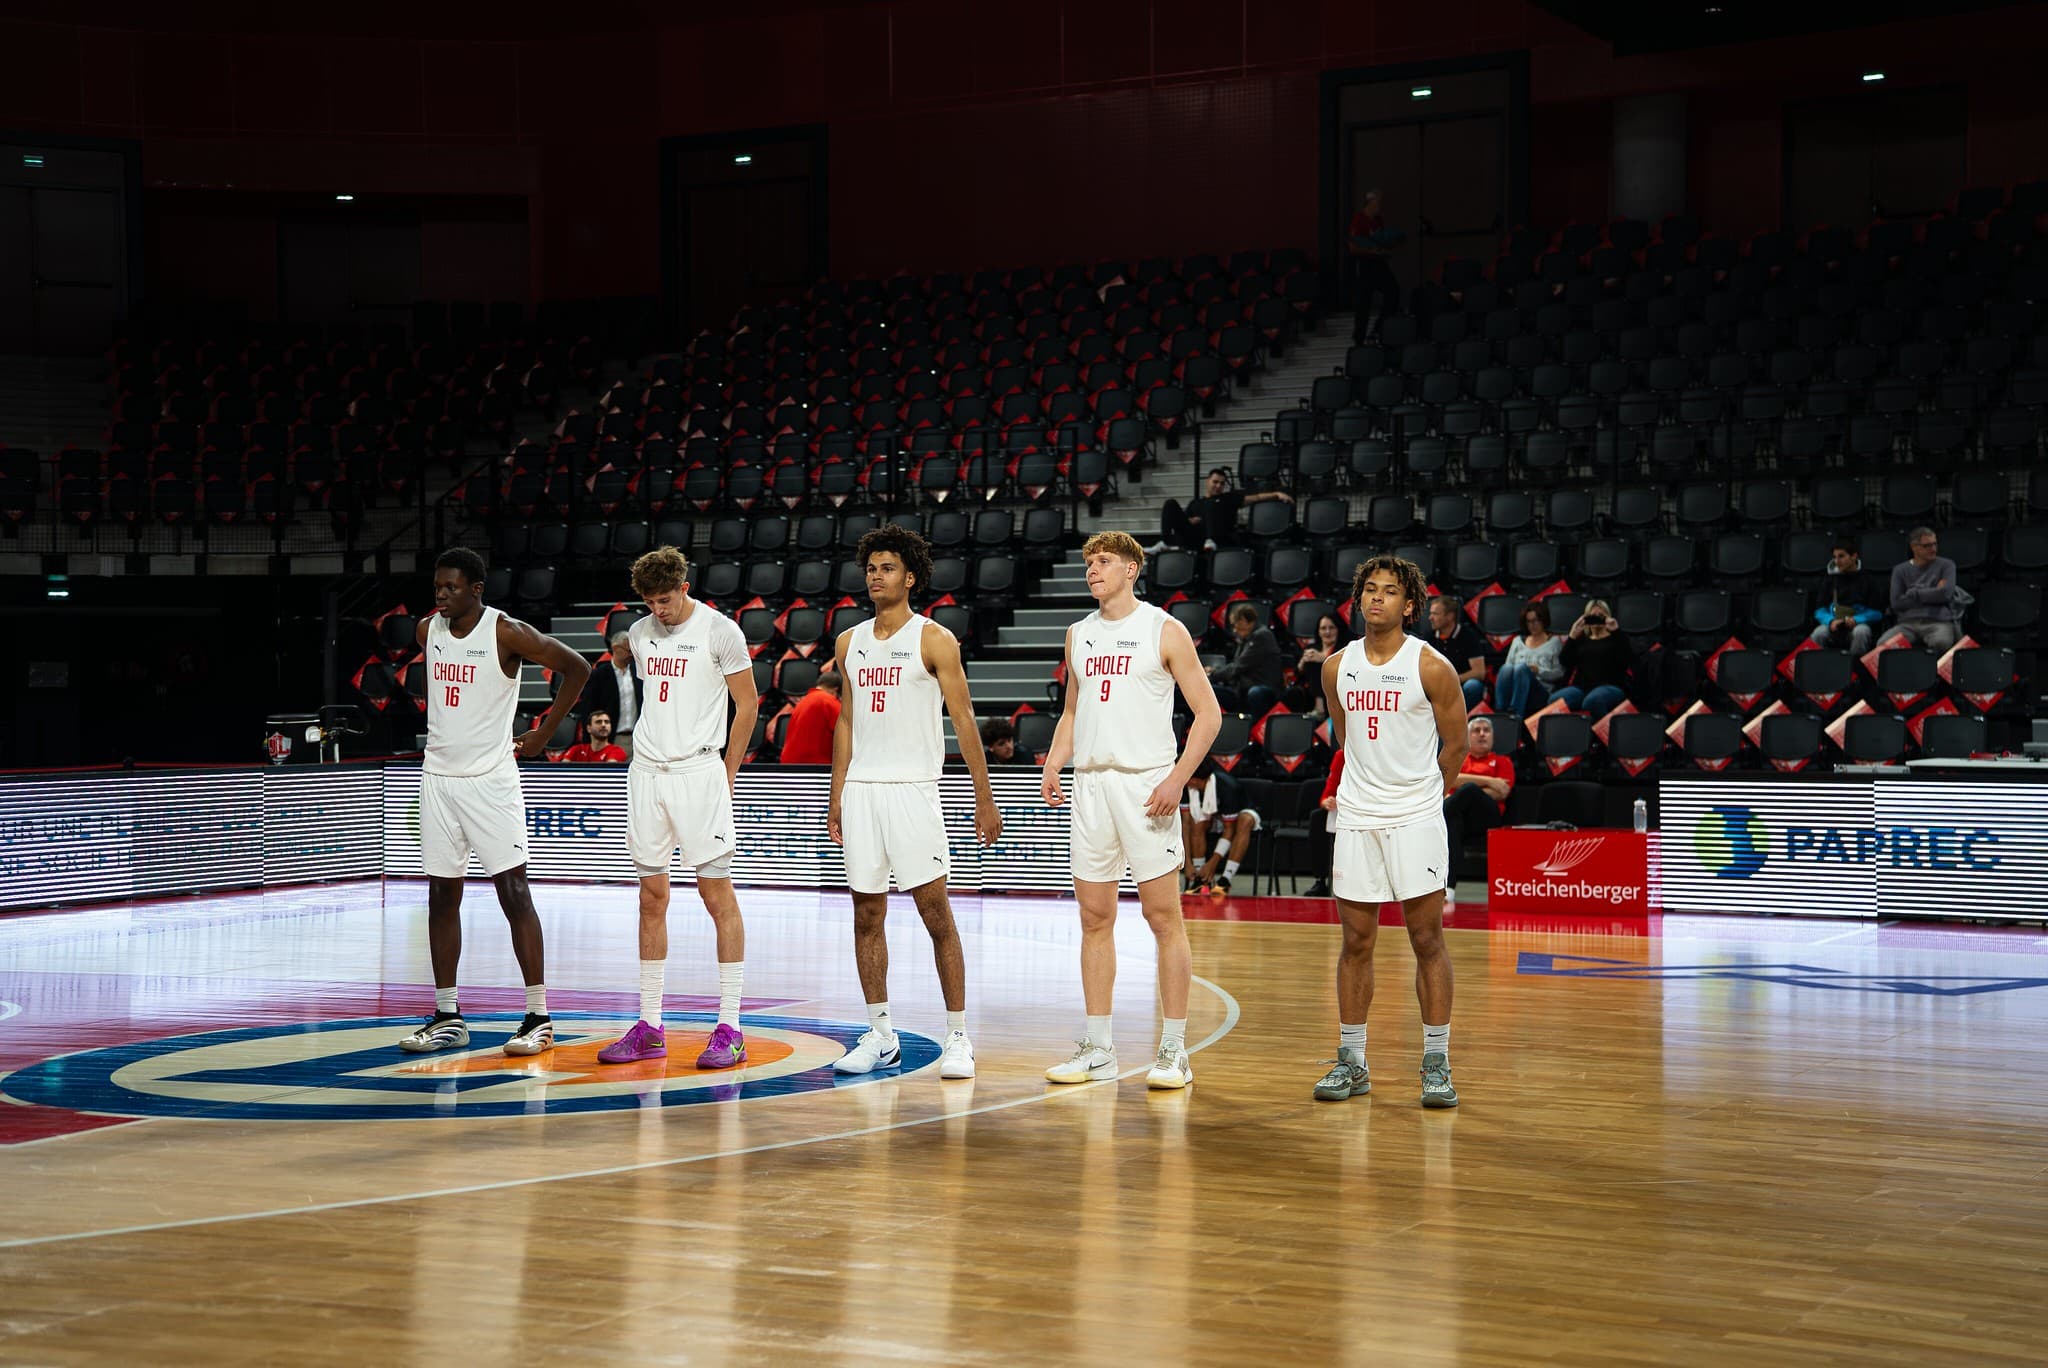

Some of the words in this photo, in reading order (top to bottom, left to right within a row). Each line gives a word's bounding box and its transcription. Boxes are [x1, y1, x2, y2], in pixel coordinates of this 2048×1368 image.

[433, 662, 477, 684] CHOLET
[647, 656, 689, 678] CHOLET
[858, 666, 903, 688] CHOLET
[1085, 655, 1132, 677] CHOLET
[444, 686, 461, 707] 16
[659, 681, 669, 702] 8
[1100, 679, 1111, 702] 9
[1346, 690, 1402, 713] CHOLET
[871, 691, 886, 713] 15
[1367, 716, 1379, 740] 5
[526, 807, 603, 838] REC
[1786, 827, 2001, 871] PAPREC
[1494, 877, 1641, 904] Streichenberger
